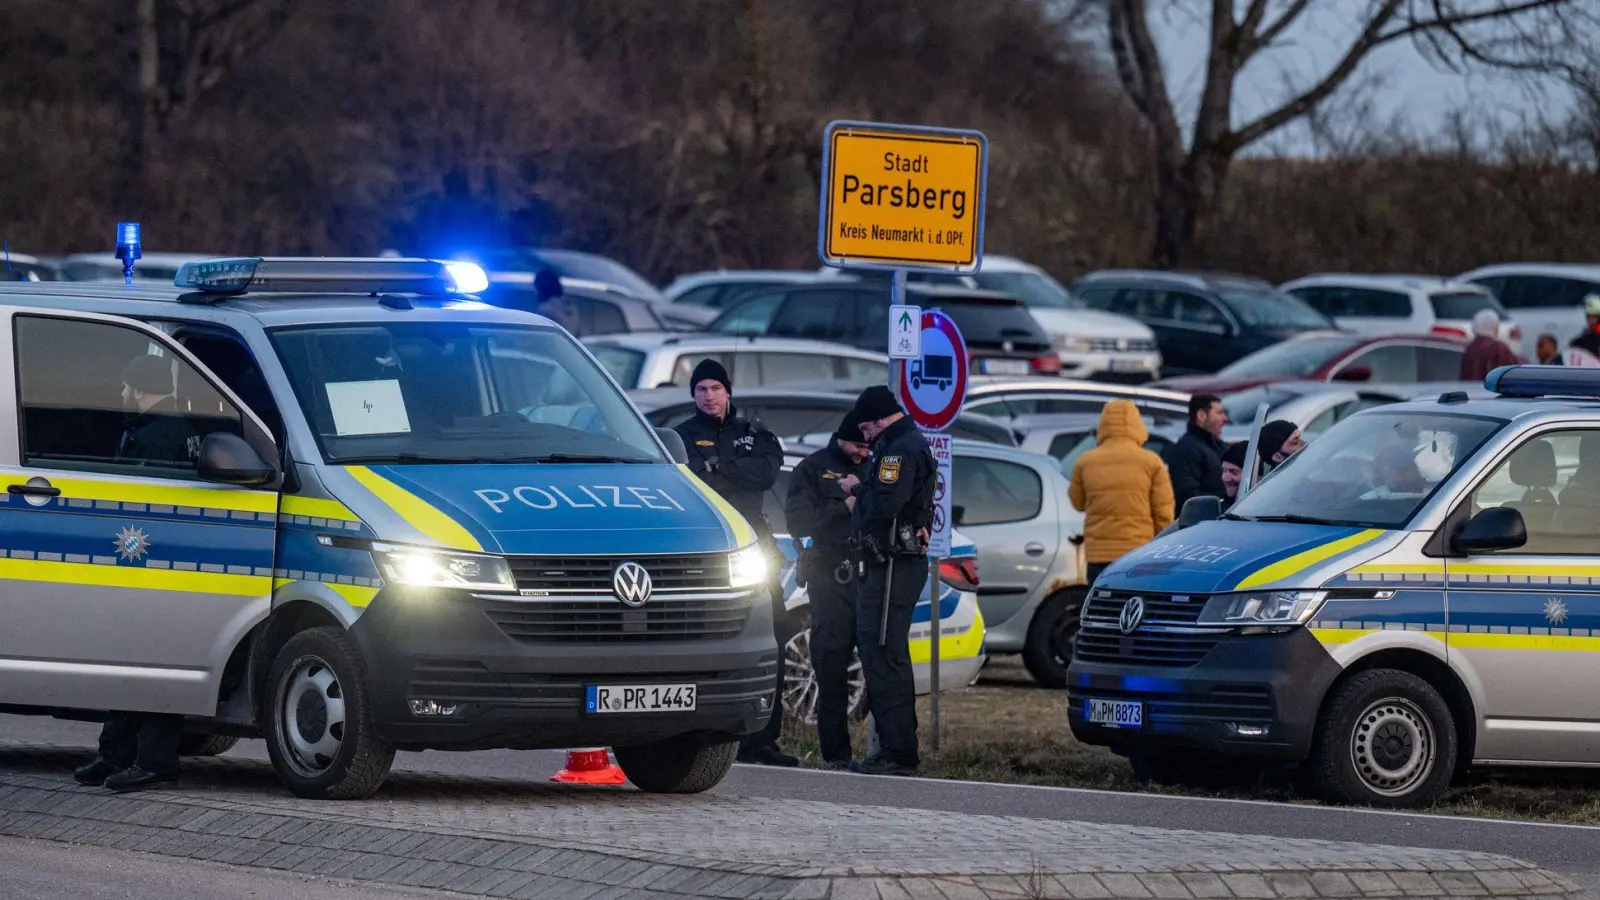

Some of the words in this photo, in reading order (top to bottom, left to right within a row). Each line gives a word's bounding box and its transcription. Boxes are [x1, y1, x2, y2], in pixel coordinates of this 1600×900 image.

[884, 152, 929, 173] Stadt
[842, 174, 966, 219] Parsberg
[840, 222, 867, 240] Kreis
[872, 224, 924, 243] Neumarkt
[927, 437, 949, 449] VAT
[473, 485, 686, 513] POLIZEI
[1142, 545, 1238, 563] POLIZEI
[651, 687, 694, 708] 1443
